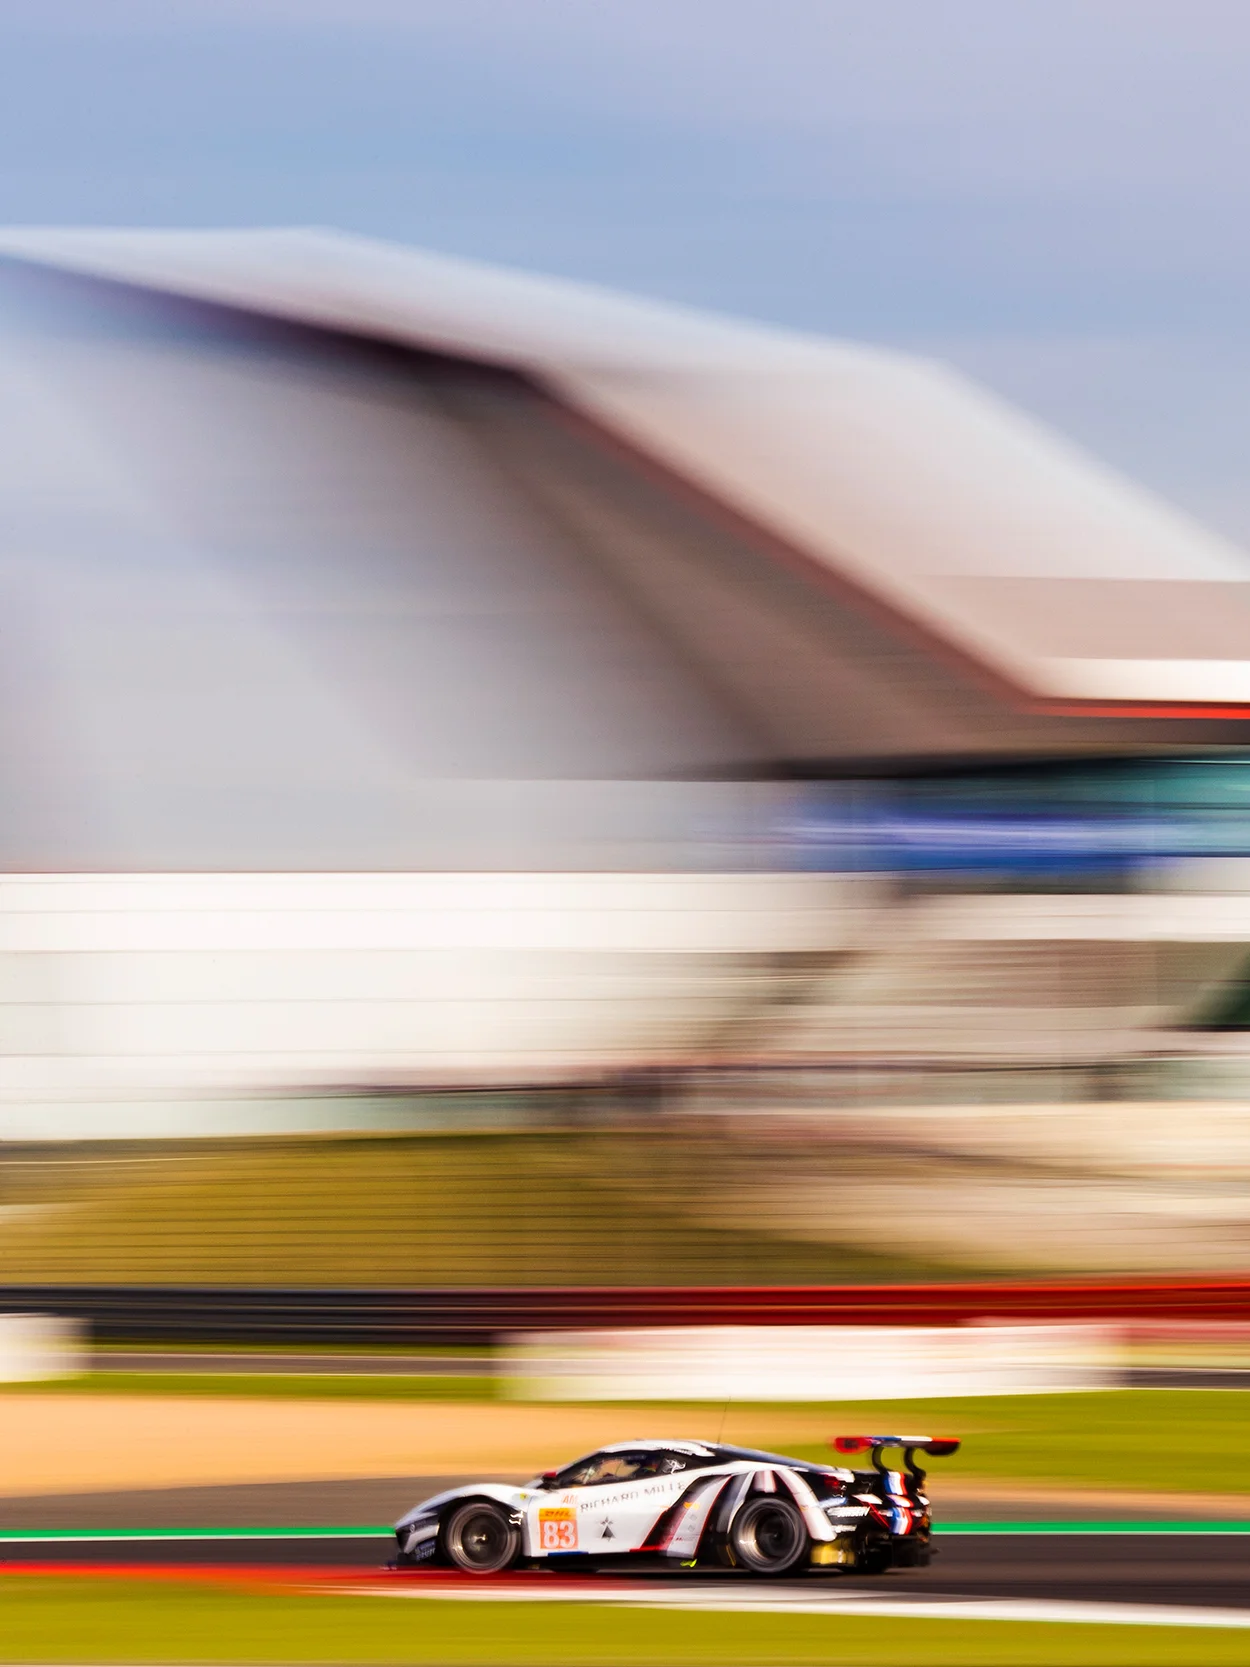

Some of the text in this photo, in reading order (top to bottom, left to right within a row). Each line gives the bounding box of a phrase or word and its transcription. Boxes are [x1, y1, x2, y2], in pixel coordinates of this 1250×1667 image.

[580, 1481, 686, 1513] RICHARD MILLE
[543, 1521, 576, 1549] 83
